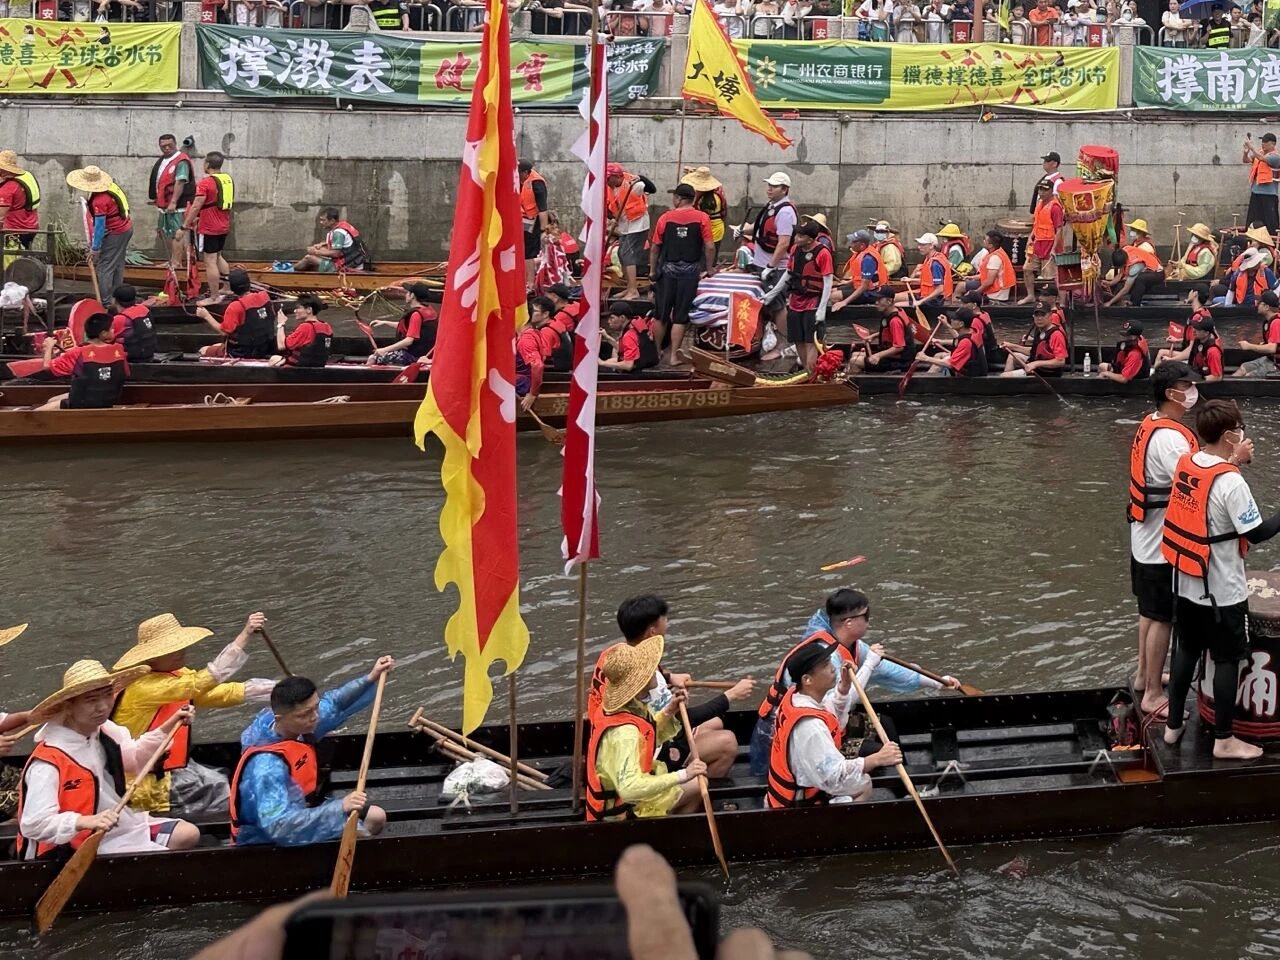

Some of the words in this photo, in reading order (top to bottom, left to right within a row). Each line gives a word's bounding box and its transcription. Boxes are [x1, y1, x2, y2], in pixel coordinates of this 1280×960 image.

[782, 63, 883, 79] 广州农商银行
[601, 391, 731, 410] 18928557999
